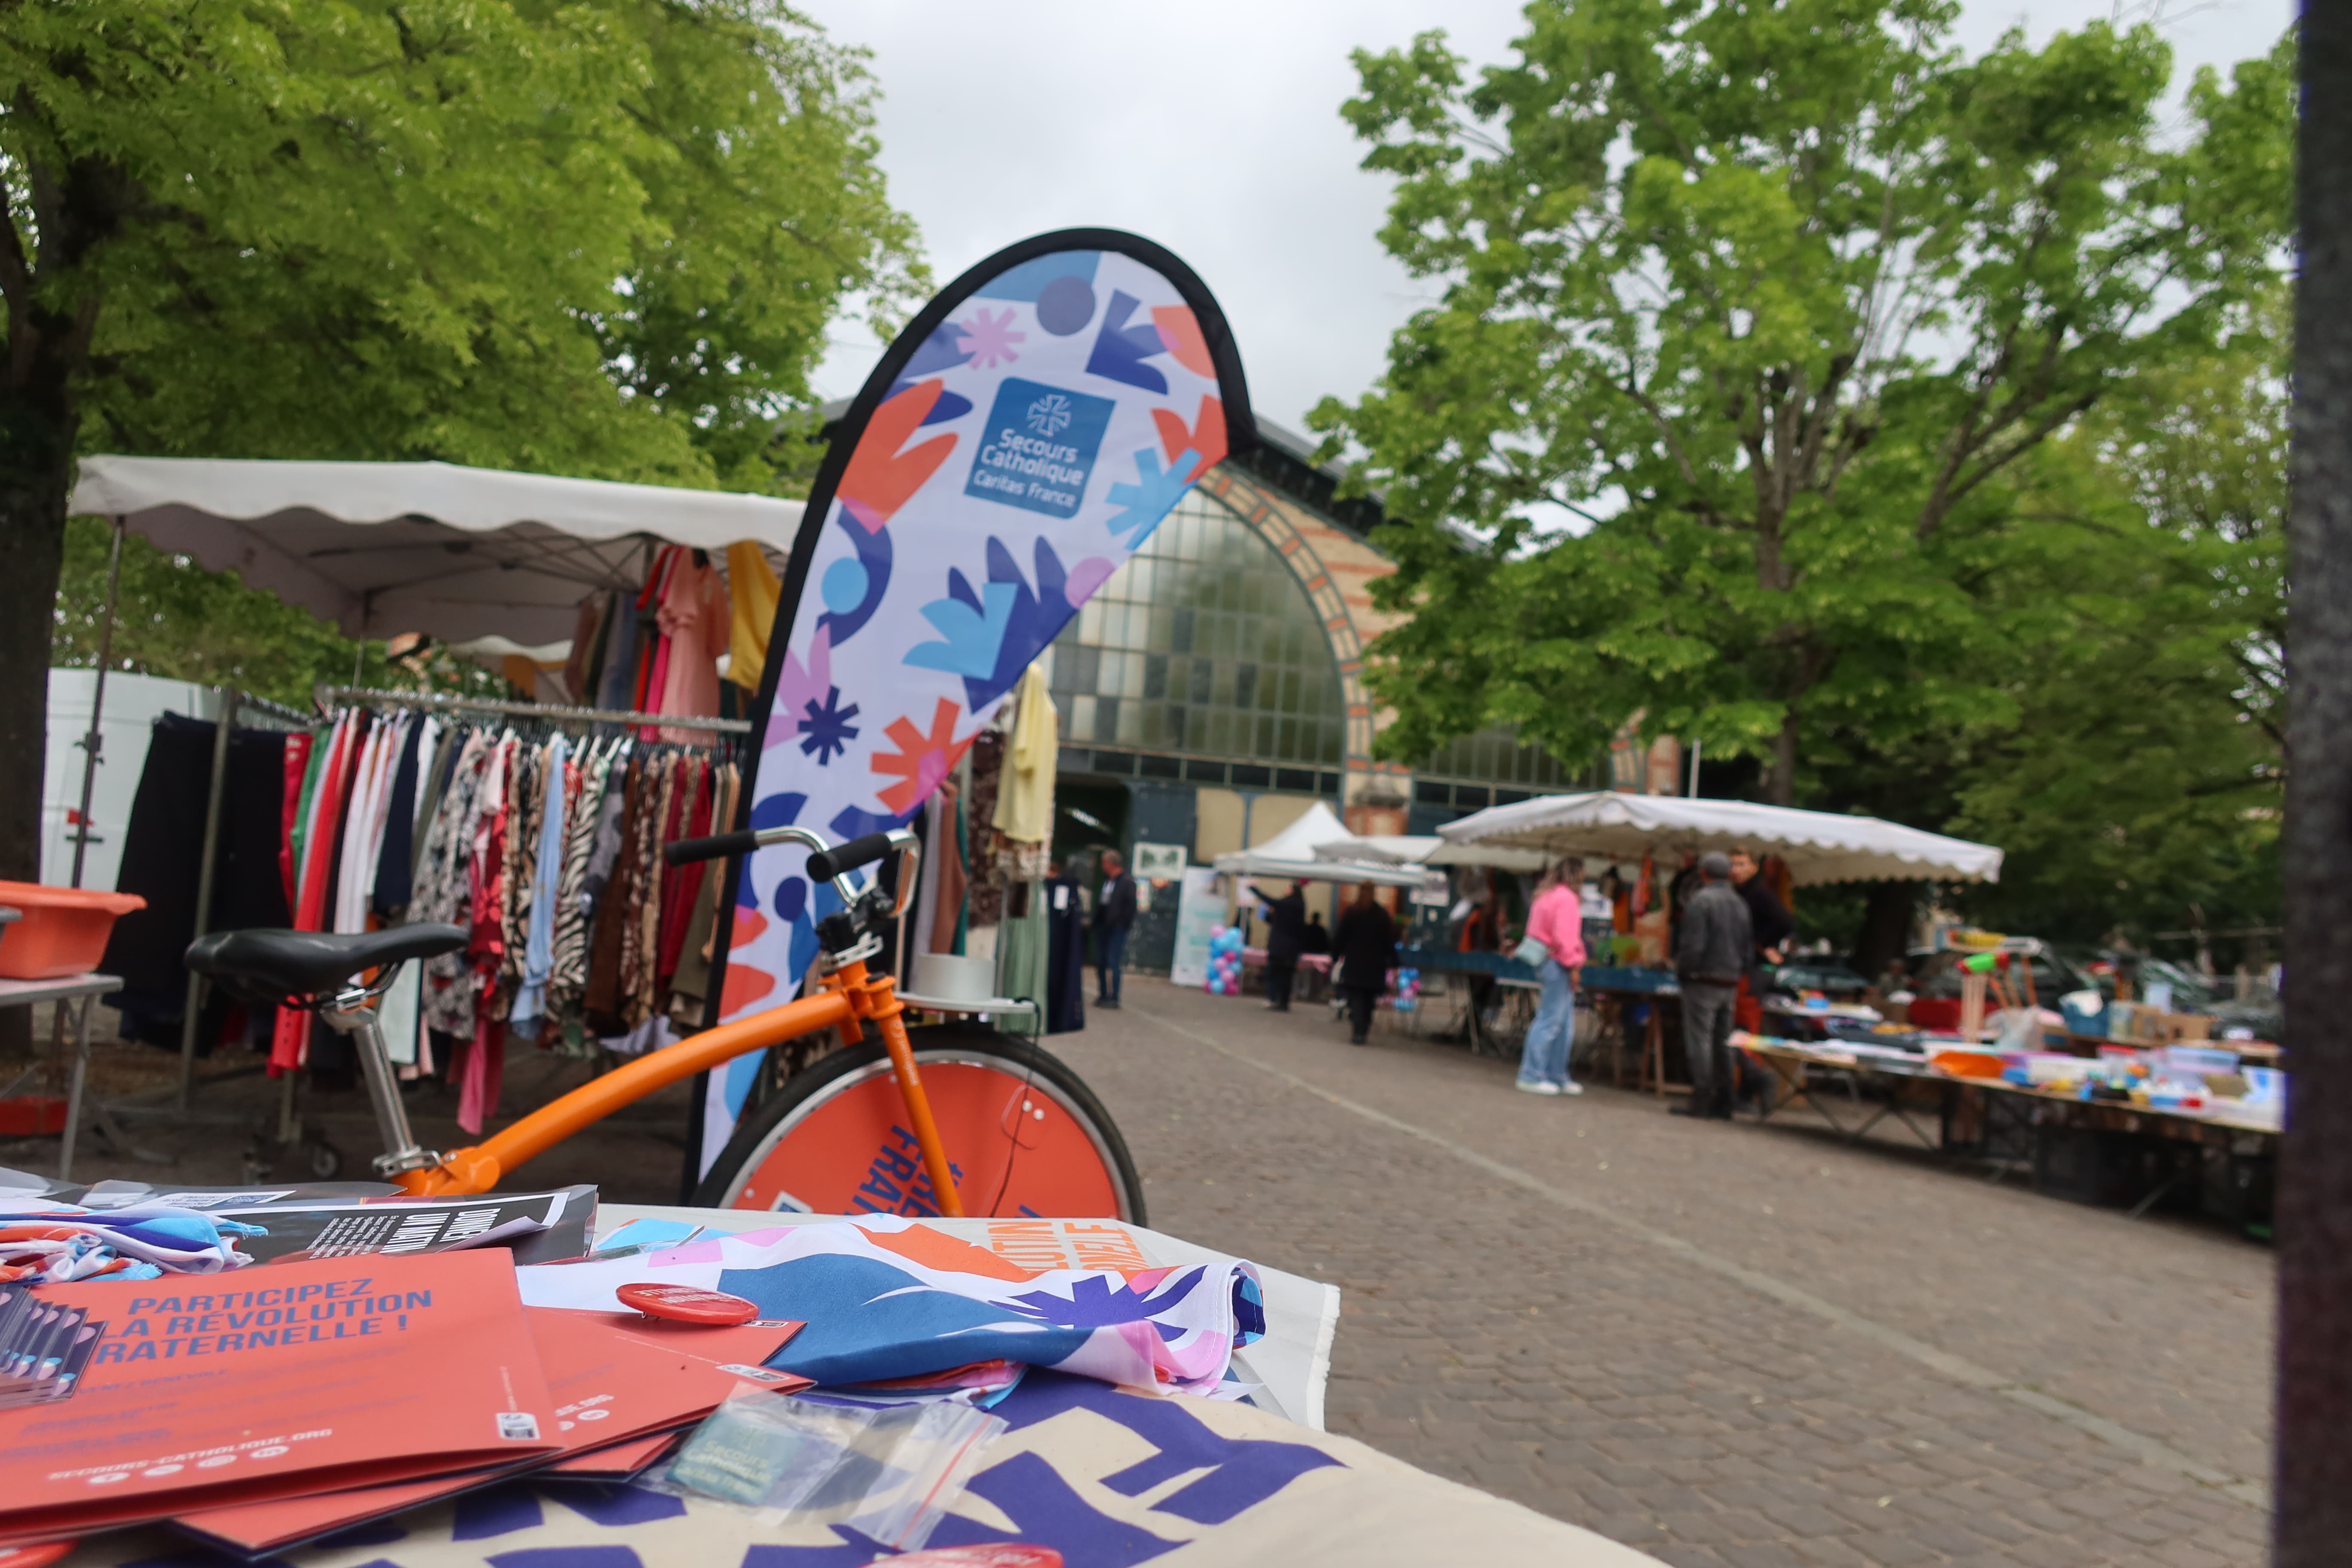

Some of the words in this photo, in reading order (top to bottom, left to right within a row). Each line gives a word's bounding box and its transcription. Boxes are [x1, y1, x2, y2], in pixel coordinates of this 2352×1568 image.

[998, 428, 1078, 463] Secours
[980, 444, 1084, 486] Catholique
[973, 469, 1026, 496] Caritas
[401, 1213, 451, 1226] UN
[379, 1225, 442, 1254] MATIN
[128, 1278, 373, 1315] PARTICIPEZ
[166, 1289, 431, 1335] RÉVOLUTION
[397, 1314, 407, 1331] !
